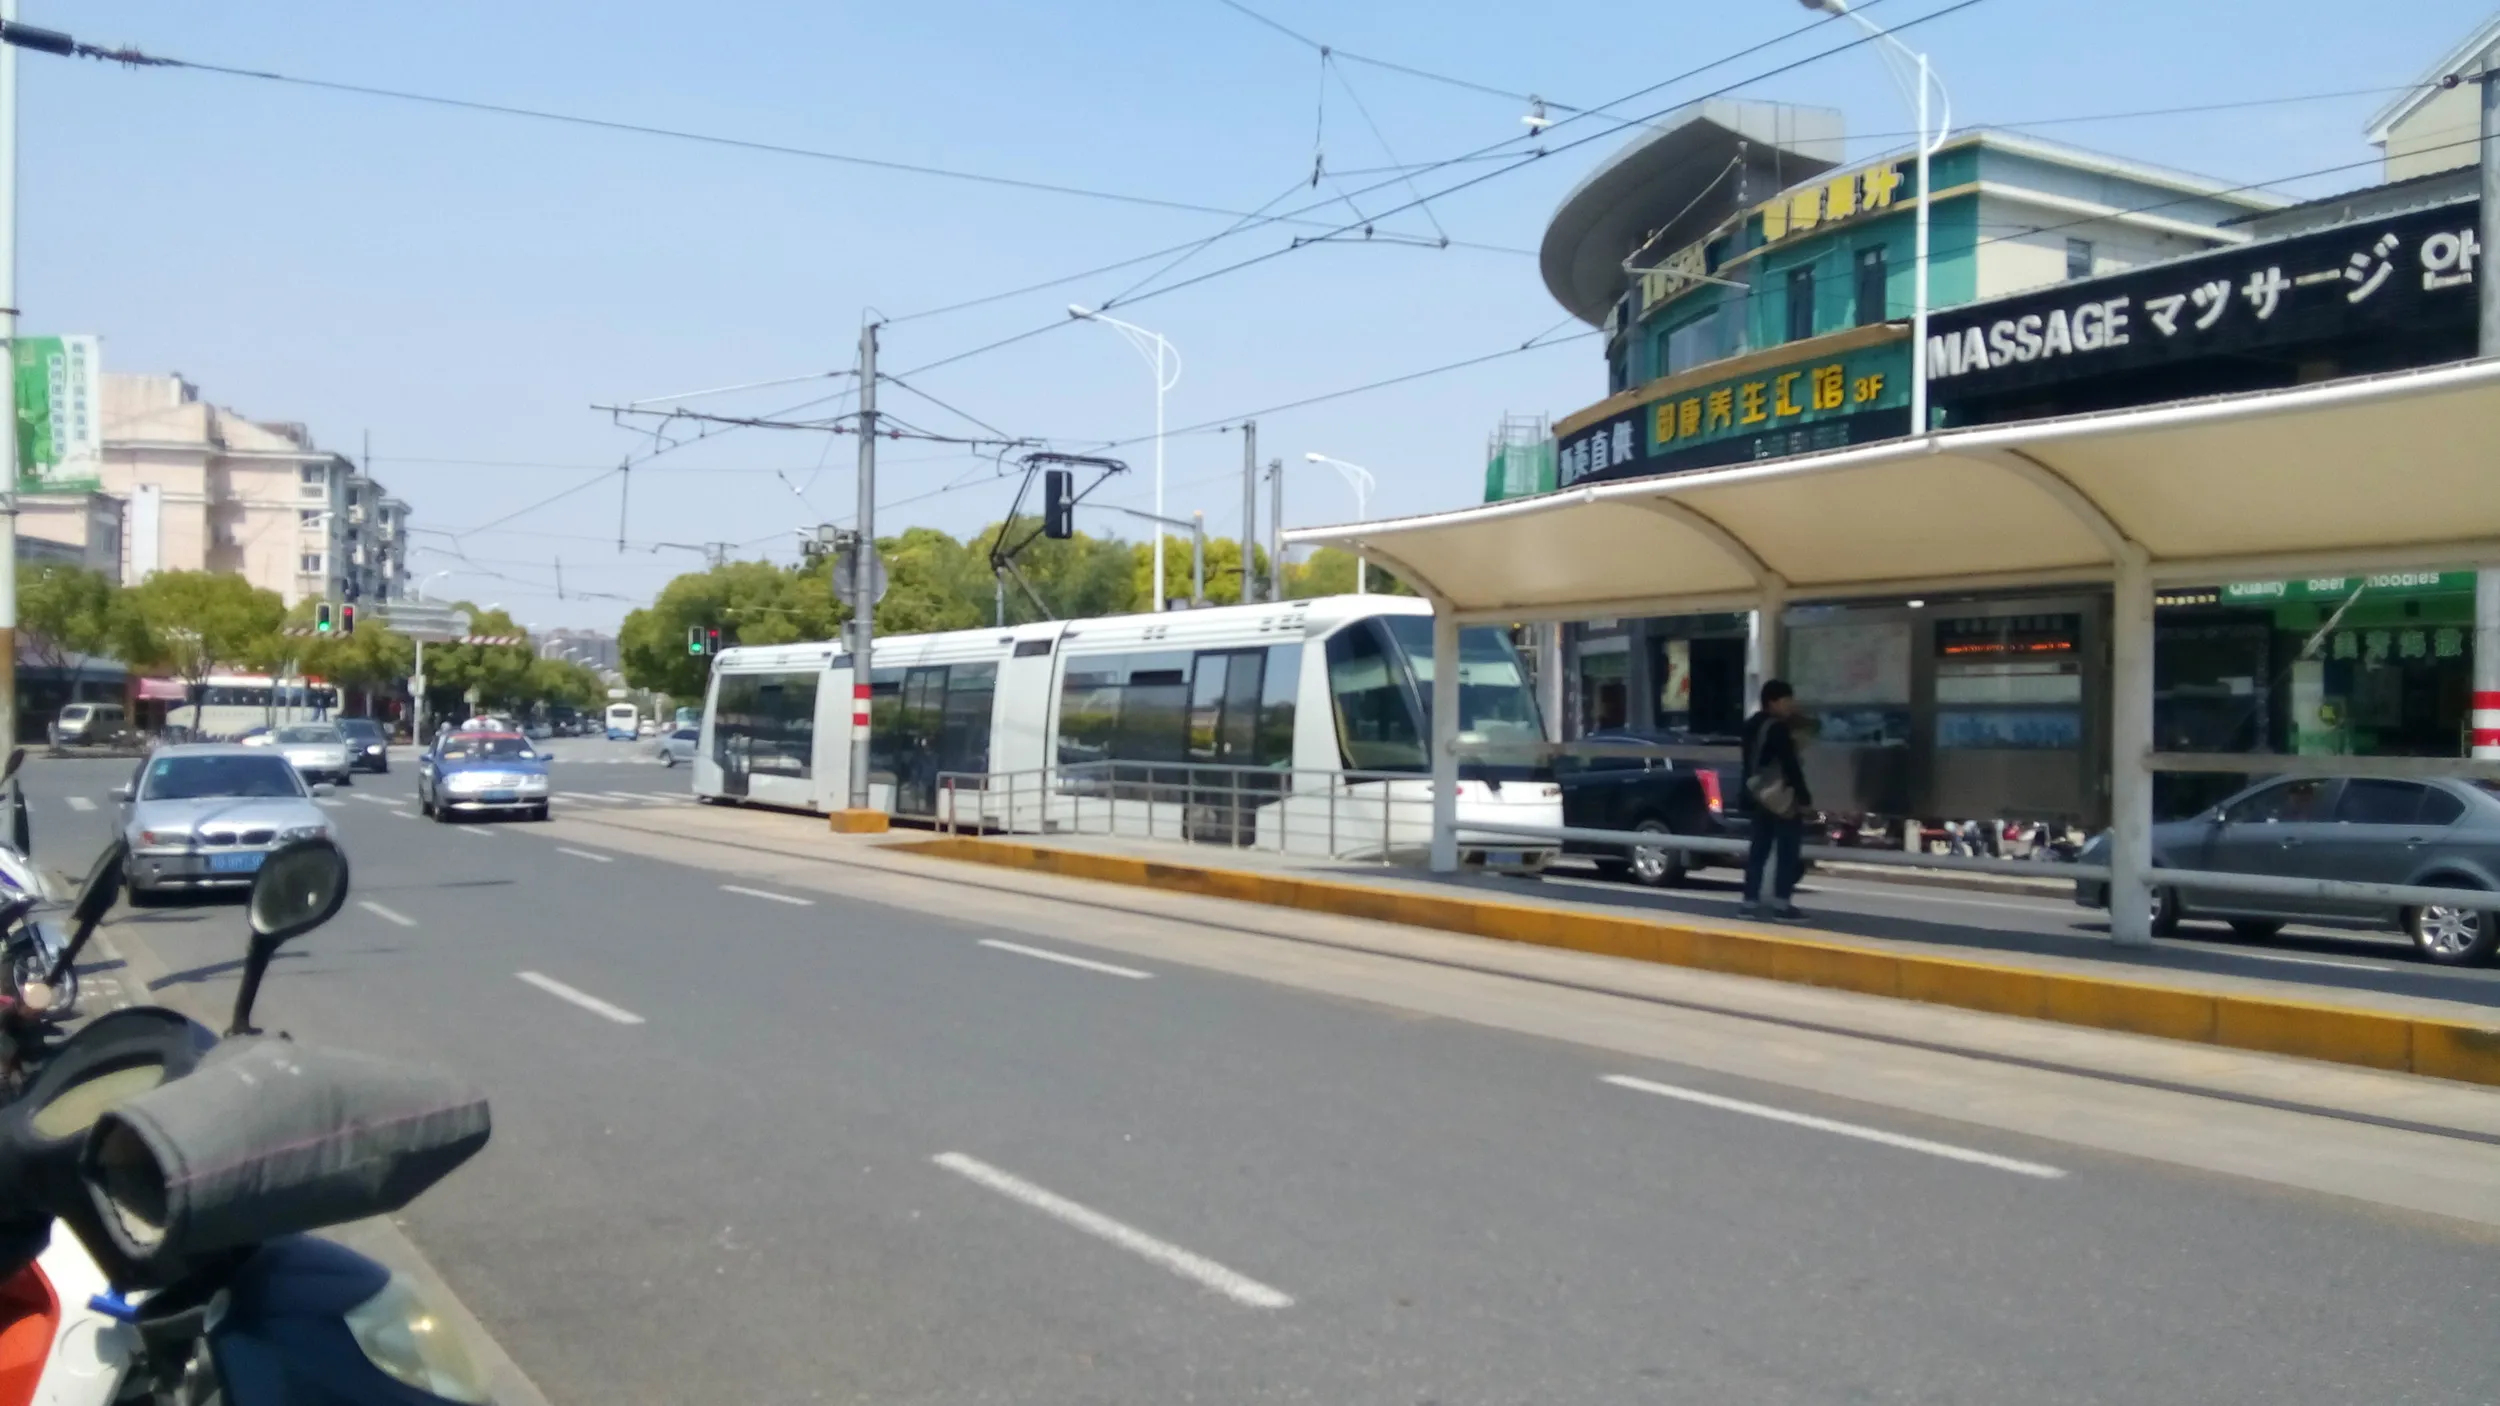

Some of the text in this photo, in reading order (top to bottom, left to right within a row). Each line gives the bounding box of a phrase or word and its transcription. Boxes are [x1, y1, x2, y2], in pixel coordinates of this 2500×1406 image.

[2420, 228, 2480, 290] 안
[1927, 296, 2130, 380] MASSAGE
[1853, 373, 1884, 403] 3F
